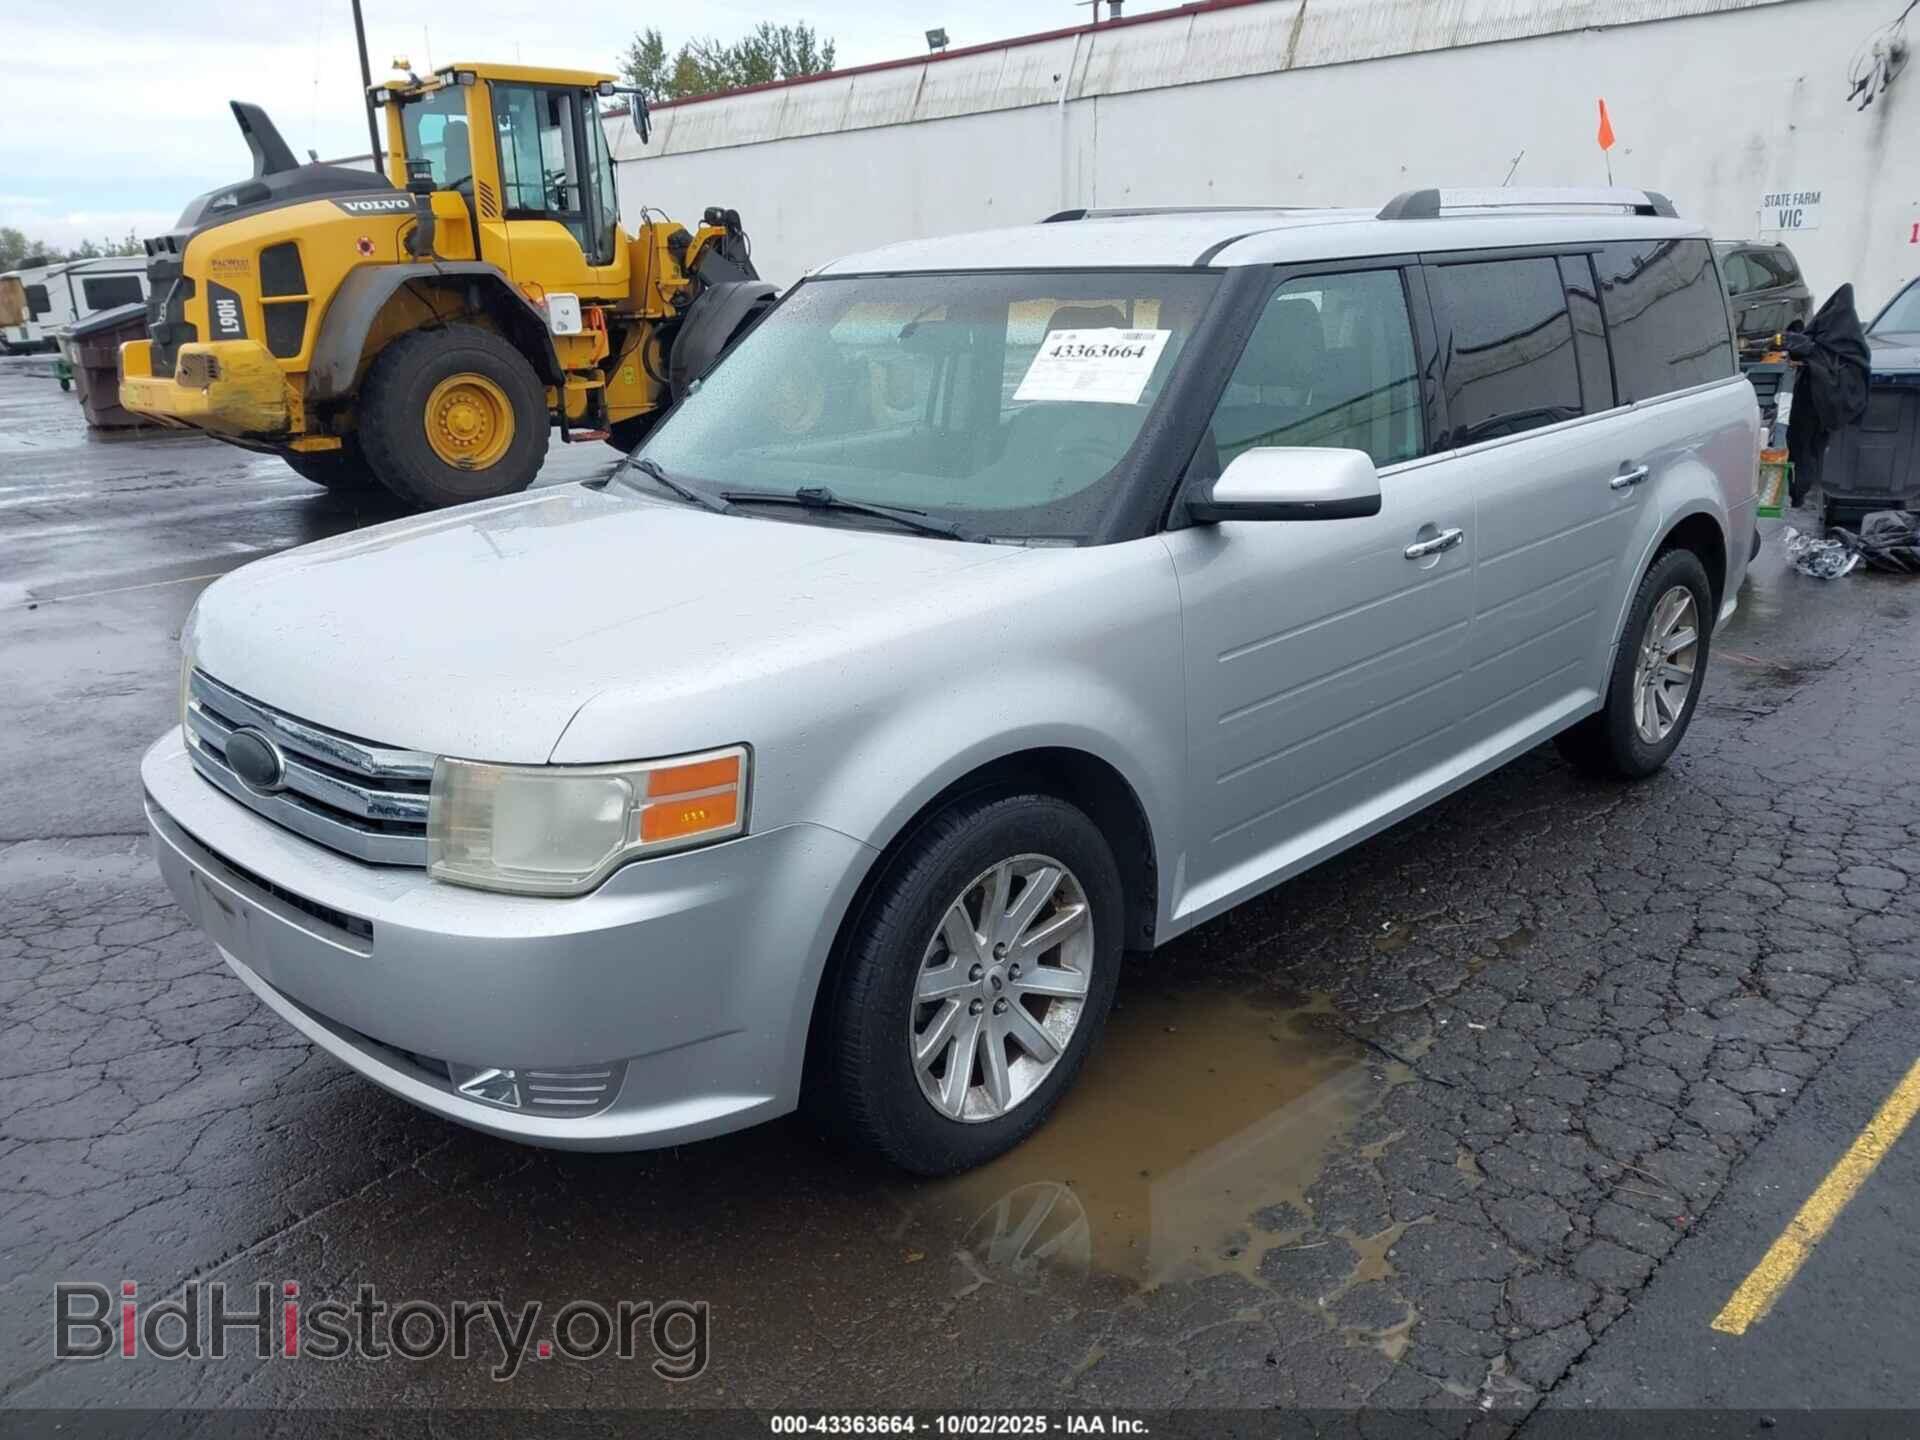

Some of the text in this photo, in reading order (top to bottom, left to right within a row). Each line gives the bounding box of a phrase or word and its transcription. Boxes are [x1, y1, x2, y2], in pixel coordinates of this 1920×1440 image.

[343, 200, 410, 211] VOLVO
[1764, 192, 1821, 208] STATE FARM
[1779, 209, 1802, 228] VIC
[215, 299, 240, 332] L90H
[1050, 344, 1147, 358] 43363664
